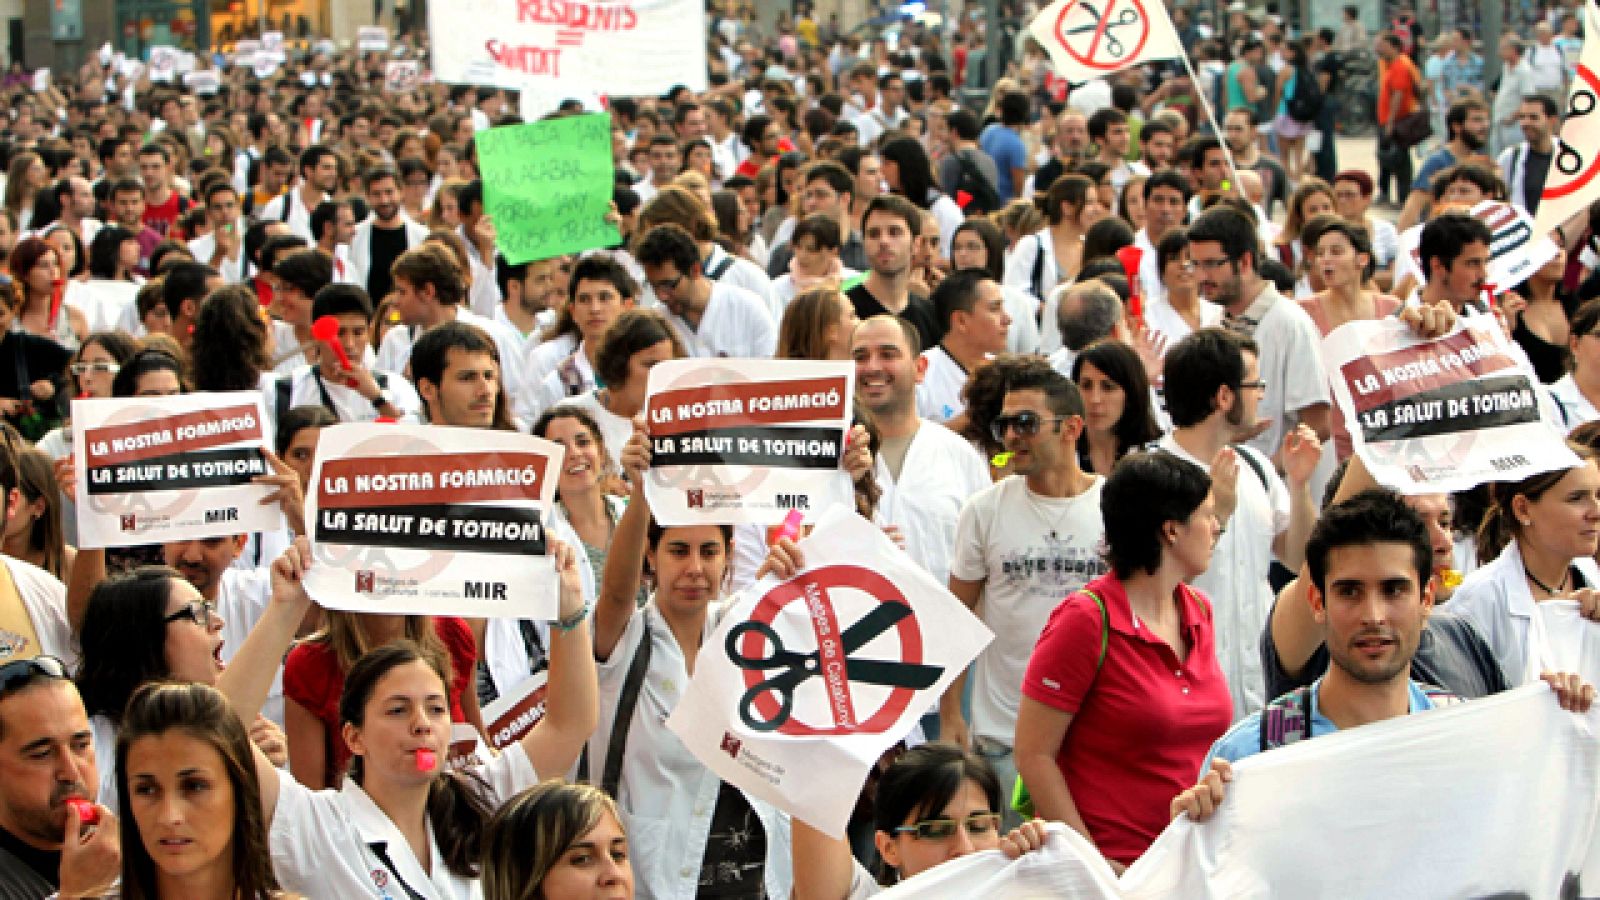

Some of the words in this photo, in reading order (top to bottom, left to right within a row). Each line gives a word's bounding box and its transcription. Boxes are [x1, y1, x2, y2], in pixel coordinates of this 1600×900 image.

[1354, 374, 1381, 395] LA
[1382, 357, 1439, 386] NOSTRA
[652, 407, 673, 424] LA
[677, 399, 744, 421] NOSTRA
[749, 387, 840, 413] FORMACIÓ
[1363, 409, 1389, 428] LA
[1392, 402, 1443, 424] SALUT
[1449, 400, 1470, 417] DE
[1473, 389, 1533, 416] TOTHOM
[89, 441, 109, 456] LA
[112, 429, 173, 452] NOSTRA
[176, 411, 256, 441] FORMACIÓ
[654, 438, 676, 454] LA
[680, 436, 733, 454] SALUT
[737, 438, 761, 454] DE
[763, 439, 836, 456] TOTHOM
[92, 468, 111, 484] LA
[116, 463, 163, 484] SALUT
[167, 462, 190, 479] DE
[192, 458, 264, 478] TOTHOM
[324, 476, 348, 494] LA
[355, 472, 434, 493] NOSTRA
[440, 465, 536, 489] FORMACIÓ
[776, 494, 810, 509] MIR
[205, 507, 239, 524] MIR
[324, 510, 347, 531] LA
[352, 513, 415, 534] SALUT
[419, 517, 447, 536] DE
[452, 520, 540, 541] TOTHOM
[464, 581, 508, 601] MIR
[823, 639, 836, 658] de
